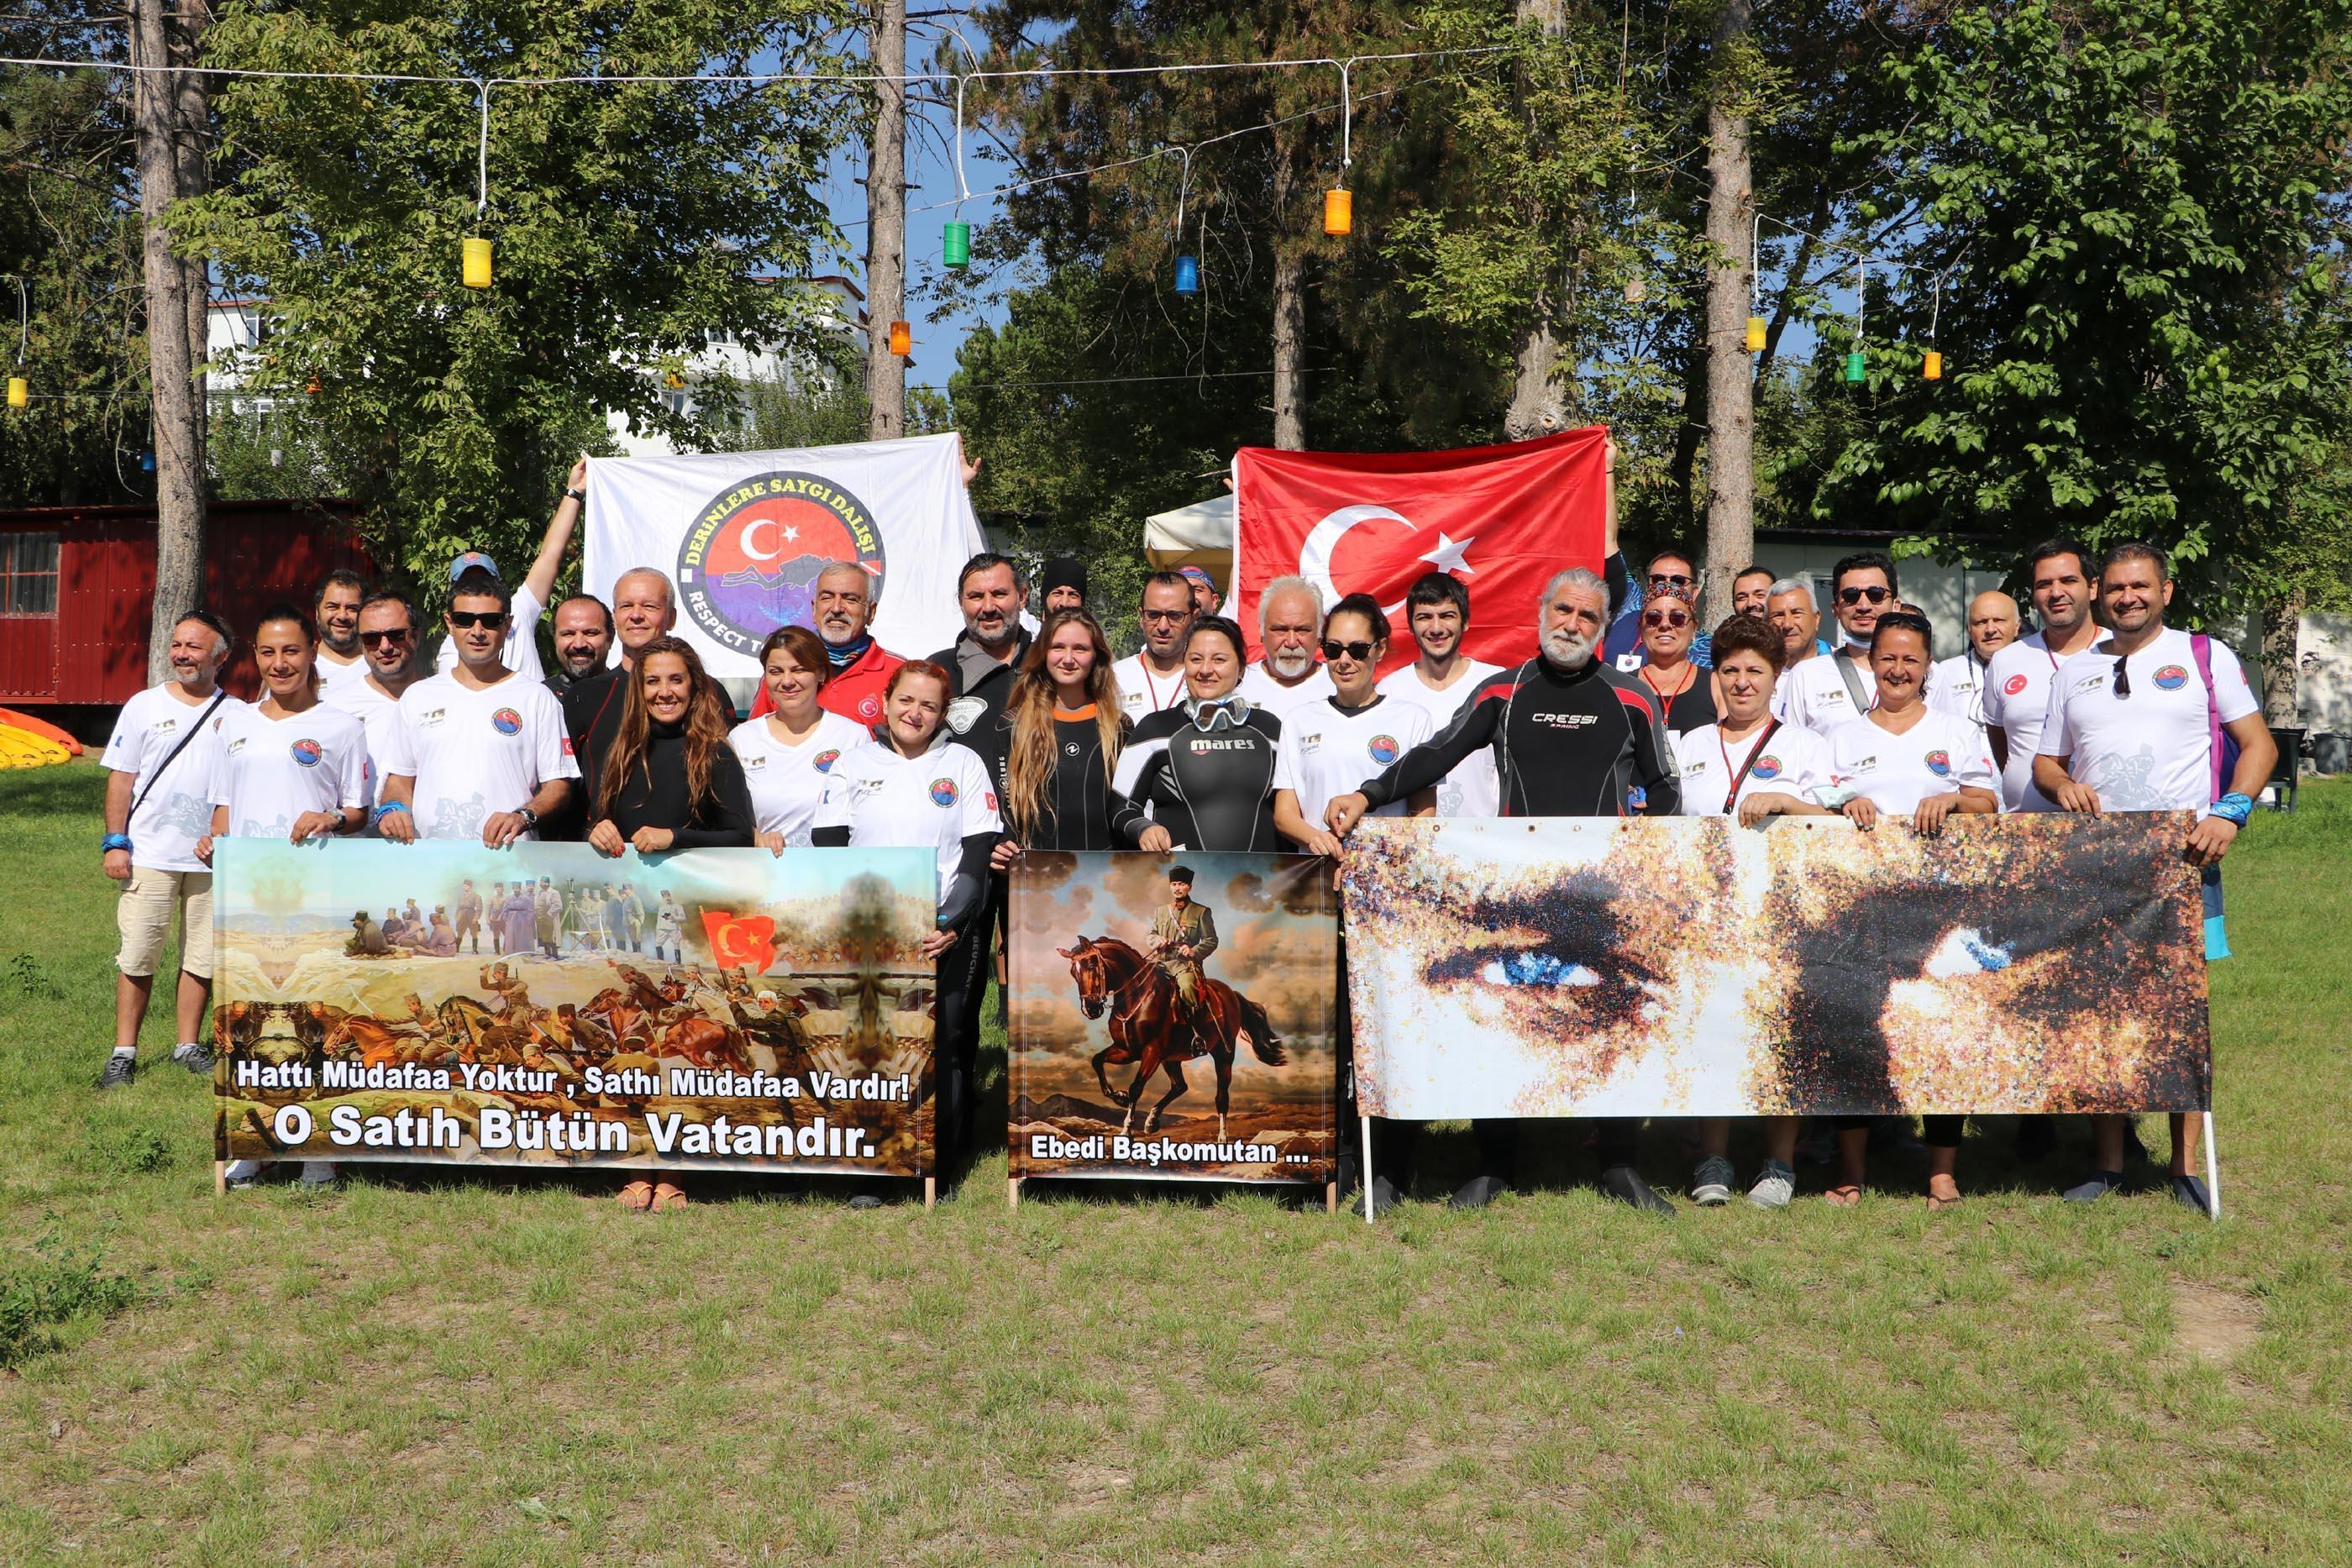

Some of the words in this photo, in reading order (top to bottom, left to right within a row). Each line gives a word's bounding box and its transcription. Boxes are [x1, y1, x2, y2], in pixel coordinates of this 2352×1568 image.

[770, 479, 832, 501] SAYGI
[829, 495, 876, 553] DALIŞI
[689, 590, 748, 647] RESPECT
[751, 639, 765, 653] T
[1531, 712, 1599, 725] CRESSI
[1190, 739, 1256, 751] mares
[237, 1061, 312, 1088] Hattı
[323, 1061, 450, 1090] Müdafaa
[584, 1066, 660, 1096] Sathı
[670, 1067, 800, 1099] Müdafaa
[809, 1071, 910, 1101] Vardır!
[274, 1104, 312, 1146] O
[329, 1104, 460, 1148] Satıh
[479, 1109, 628, 1151] Bütün
[644, 1112, 876, 1158] Vatandır.
[1031, 1135, 1105, 1160] Ebedi
[1112, 1135, 1278, 1167] Başkomutan
